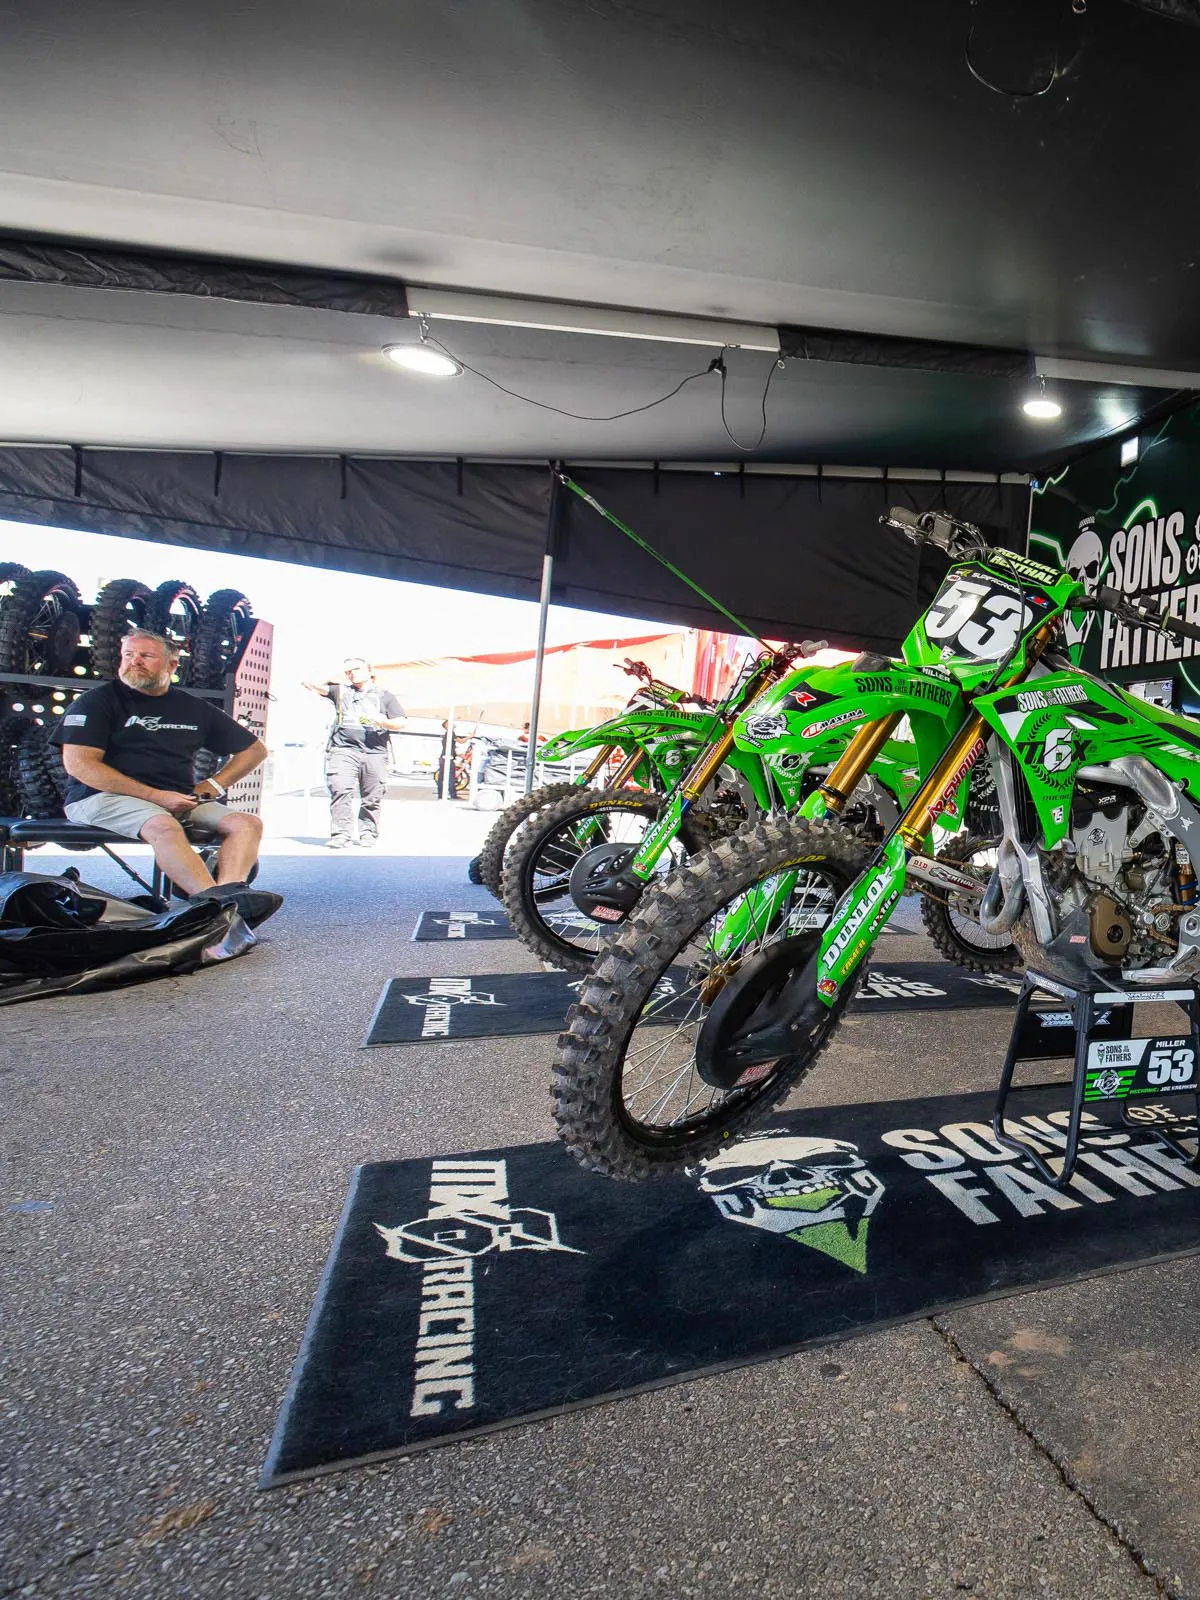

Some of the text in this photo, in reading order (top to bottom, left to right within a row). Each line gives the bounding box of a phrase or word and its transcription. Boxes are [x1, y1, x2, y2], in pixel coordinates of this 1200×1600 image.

[1106, 511, 1184, 594] SONS
[989, 555, 1054, 585] RENTHAL
[924, 580, 1034, 660] 53
[853, 676, 893, 694] SONS
[921, 666, 951, 682] MILLER
[908, 681, 953, 708] FATHERS
[1017, 691, 1049, 713] SONS
[1052, 684, 1089, 704] FATHERS
[1105, 1044, 1122, 1054] SONS
[1155, 1039, 1186, 1048] MILLER
[1105, 1053, 1132, 1063] FATHERS
[1147, 1048, 1195, 1085] 53
[880, 1110, 1132, 1171] SONS
[410, 1257, 476, 1418] RACING
